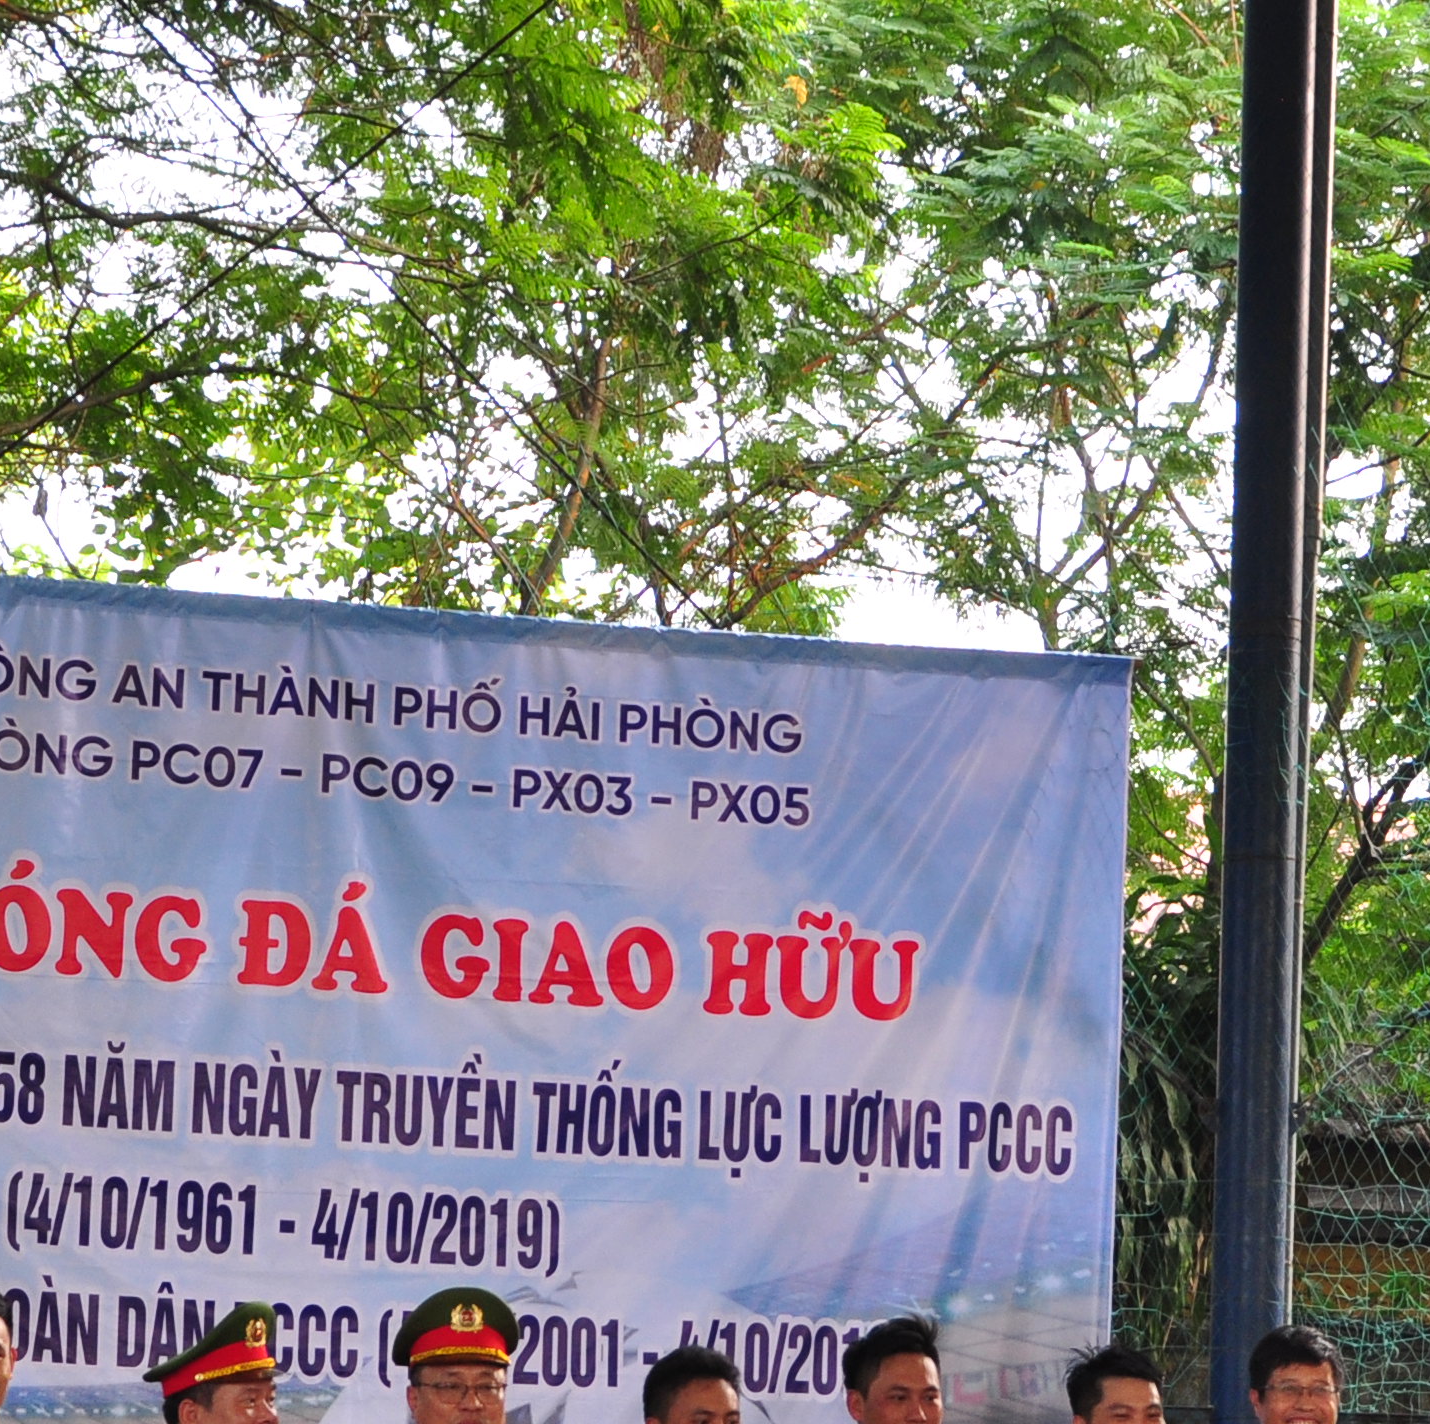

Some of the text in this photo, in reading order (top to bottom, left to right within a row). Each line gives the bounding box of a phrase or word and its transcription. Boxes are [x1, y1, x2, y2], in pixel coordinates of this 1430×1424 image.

[113, 664, 187, 711] AN
[202, 665, 375, 724] THÀNH
[393, 677, 502, 734] PHỐ
[519, 686, 601, 743] HẢI
[618, 696, 804, 754] PHÒNG
[131, 740, 264, 790] PC07
[319, 753, 455, 804] PC09
[511, 769, 633, 818] PX03
[689, 782, 811, 828] PX05
[237, 881, 389, 996] ĐÁ
[419, 913, 674, 1012] GIAO
[703, 910, 920, 1022] HỮU
[62, 1041, 175, 1133] NĂM
[192, 1049, 322, 1142] NGÀY
[336, 1054, 516, 1153] TRUYỀN
[533, 1060, 683, 1160] THỐNG
[698, 1087, 784, 1179] LỰC
[800, 1088, 942, 1185] LƯỢNG
[959, 1100, 1074, 1178] PCCC
[6, 1171, 257, 1256] (4/10/1961
[311, 1188, 562, 1278] 4/10/2019)
[0, 1275, 98, 1366] OÀN
[235, 1300, 359, 1378] CCC
